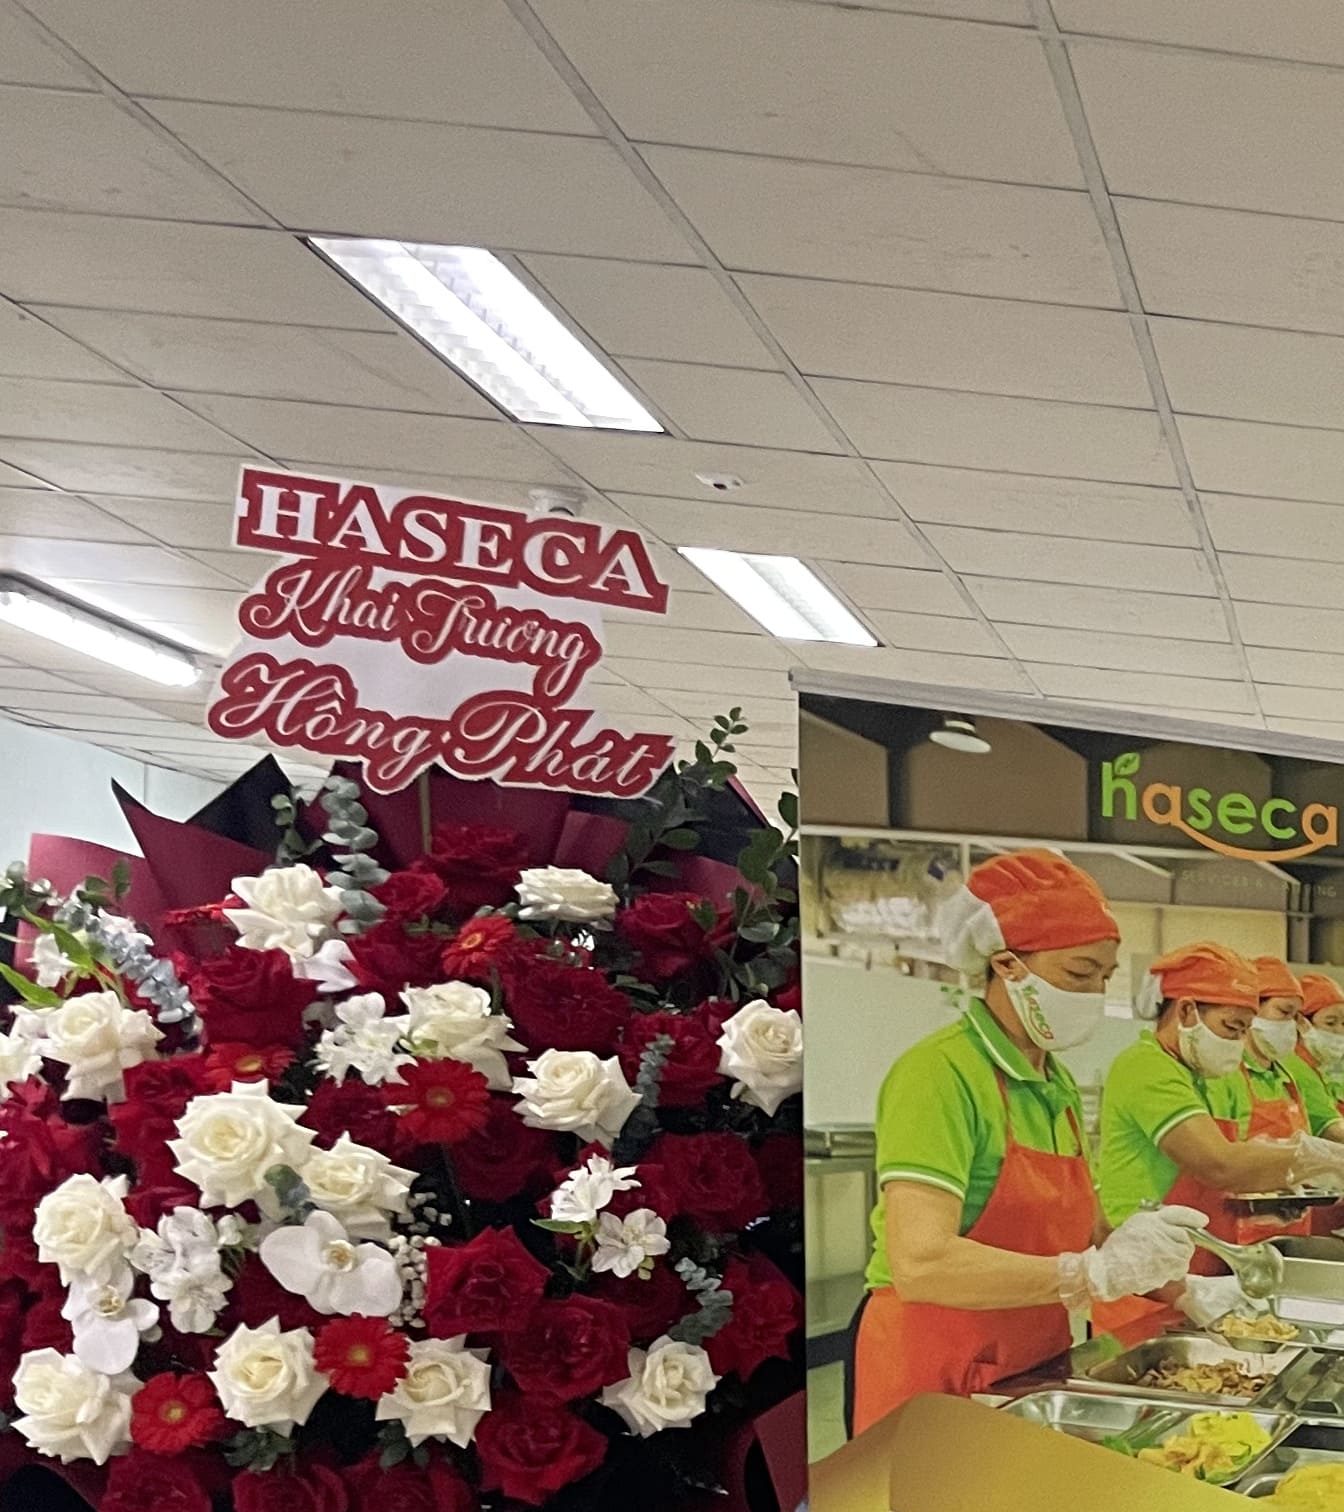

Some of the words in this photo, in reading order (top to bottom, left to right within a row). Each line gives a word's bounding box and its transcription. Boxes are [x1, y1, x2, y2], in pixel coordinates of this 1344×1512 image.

[252, 482, 655, 600] HASECA
[249, 566, 396, 638] Khai
[218, 663, 433, 782] Hồng
[456, 699, 654, 787] Phát
[1101, 753, 1339, 860] haseca
